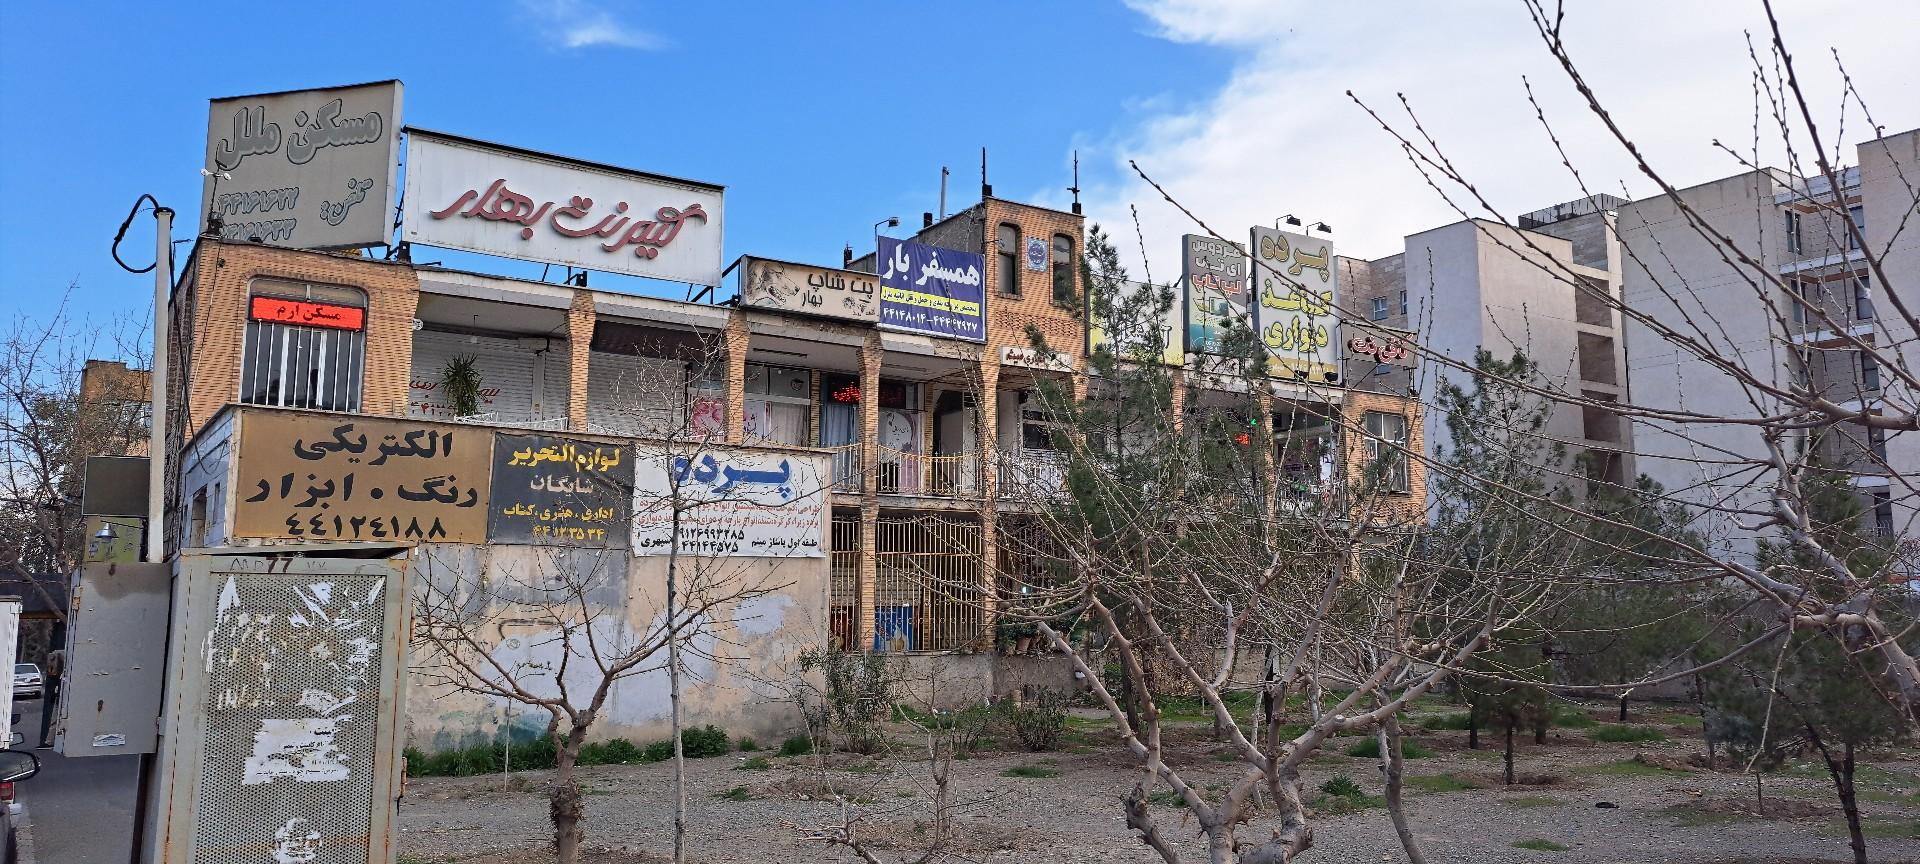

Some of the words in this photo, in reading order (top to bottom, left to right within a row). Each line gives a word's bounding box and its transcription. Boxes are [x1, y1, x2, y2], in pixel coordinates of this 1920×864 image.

[215, 106, 282, 171] ملل
[287, 98, 383, 165] مسکن
[430, 179, 555, 240] بهار
[882, 243, 910, 280] بار
[916, 246, 980, 287] همسفر
[1261, 235, 1329, 282] پرده
[802, 289, 823, 308] بهار
[807, 271, 846, 293] شاپ
[850, 276, 874, 300] پت
[1220, 280, 1242, 299] لپ
[1261, 278, 1333, 317] کاغذ
[275, 304, 300, 319] ارم
[302, 307, 341, 321] مسکن
[1264, 314, 1329, 353] دیواری
[293, 423, 453, 466] الکتریکی
[507, 442, 576, 467] التحریر
[579, 447, 620, 472] لوازم
[246, 472, 354, 510] ابزار
[397, 475, 478, 508] رنگ
[530, 474, 595, 497] شایگان
[674, 453, 792, 499] پرده
